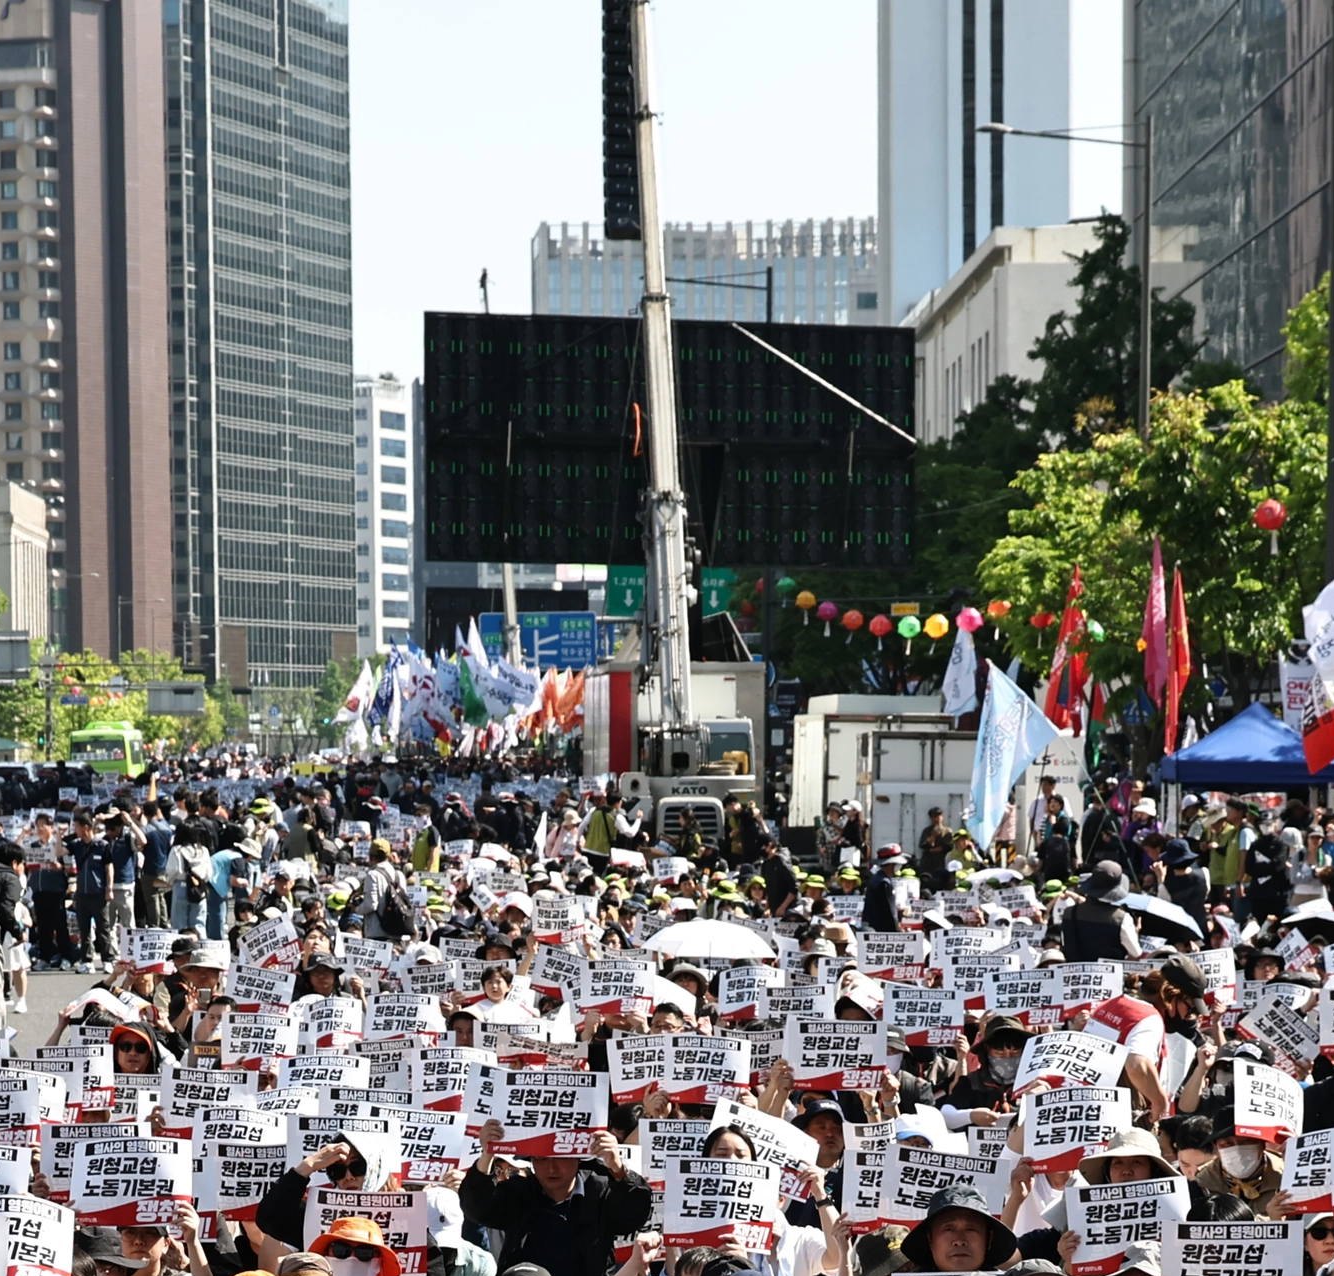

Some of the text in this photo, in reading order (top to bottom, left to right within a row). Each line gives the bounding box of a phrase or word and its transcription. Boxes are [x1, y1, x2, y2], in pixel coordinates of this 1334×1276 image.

[671, 786, 708, 795] KATO
[92, 1141, 124, 1153] 열사의
[82, 1179, 174, 1197] 노동기본권
